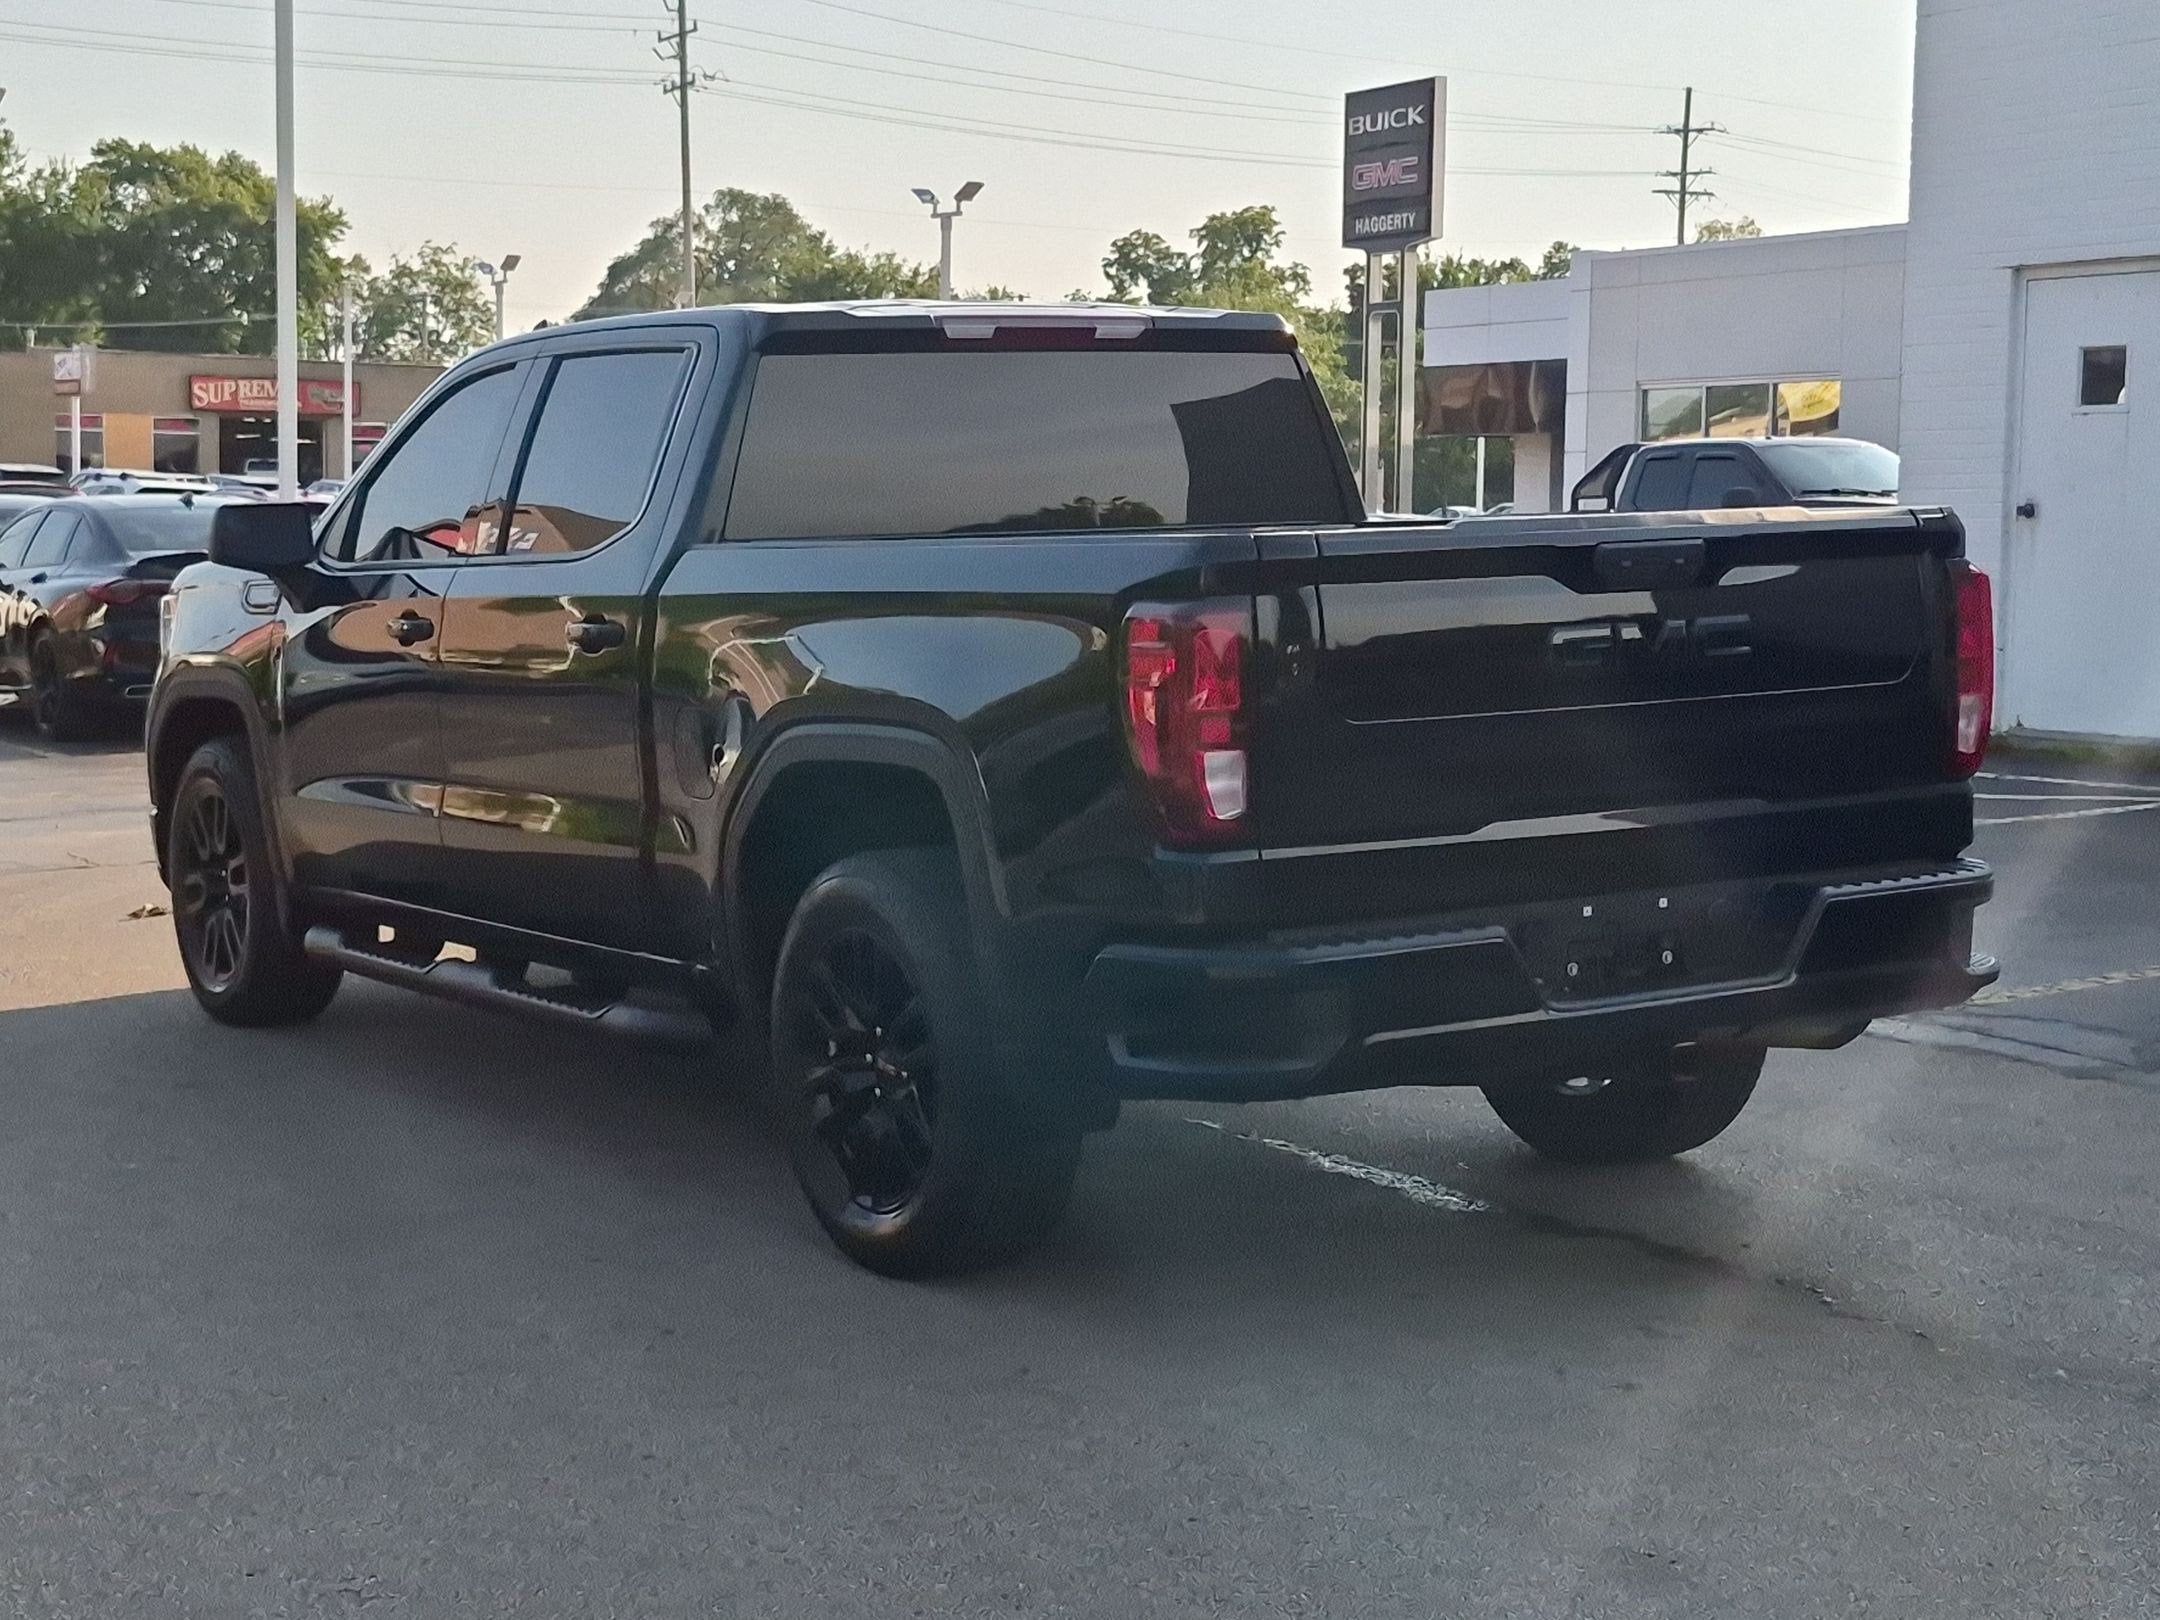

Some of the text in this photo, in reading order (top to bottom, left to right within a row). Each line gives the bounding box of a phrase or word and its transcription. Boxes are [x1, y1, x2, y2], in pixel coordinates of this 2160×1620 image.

[1349, 104, 1426, 136] BUICK
[1352, 156, 1418, 190] GMC
[1355, 212, 1416, 234] HAGGERTY
[193, 379, 278, 408] SUPREM
